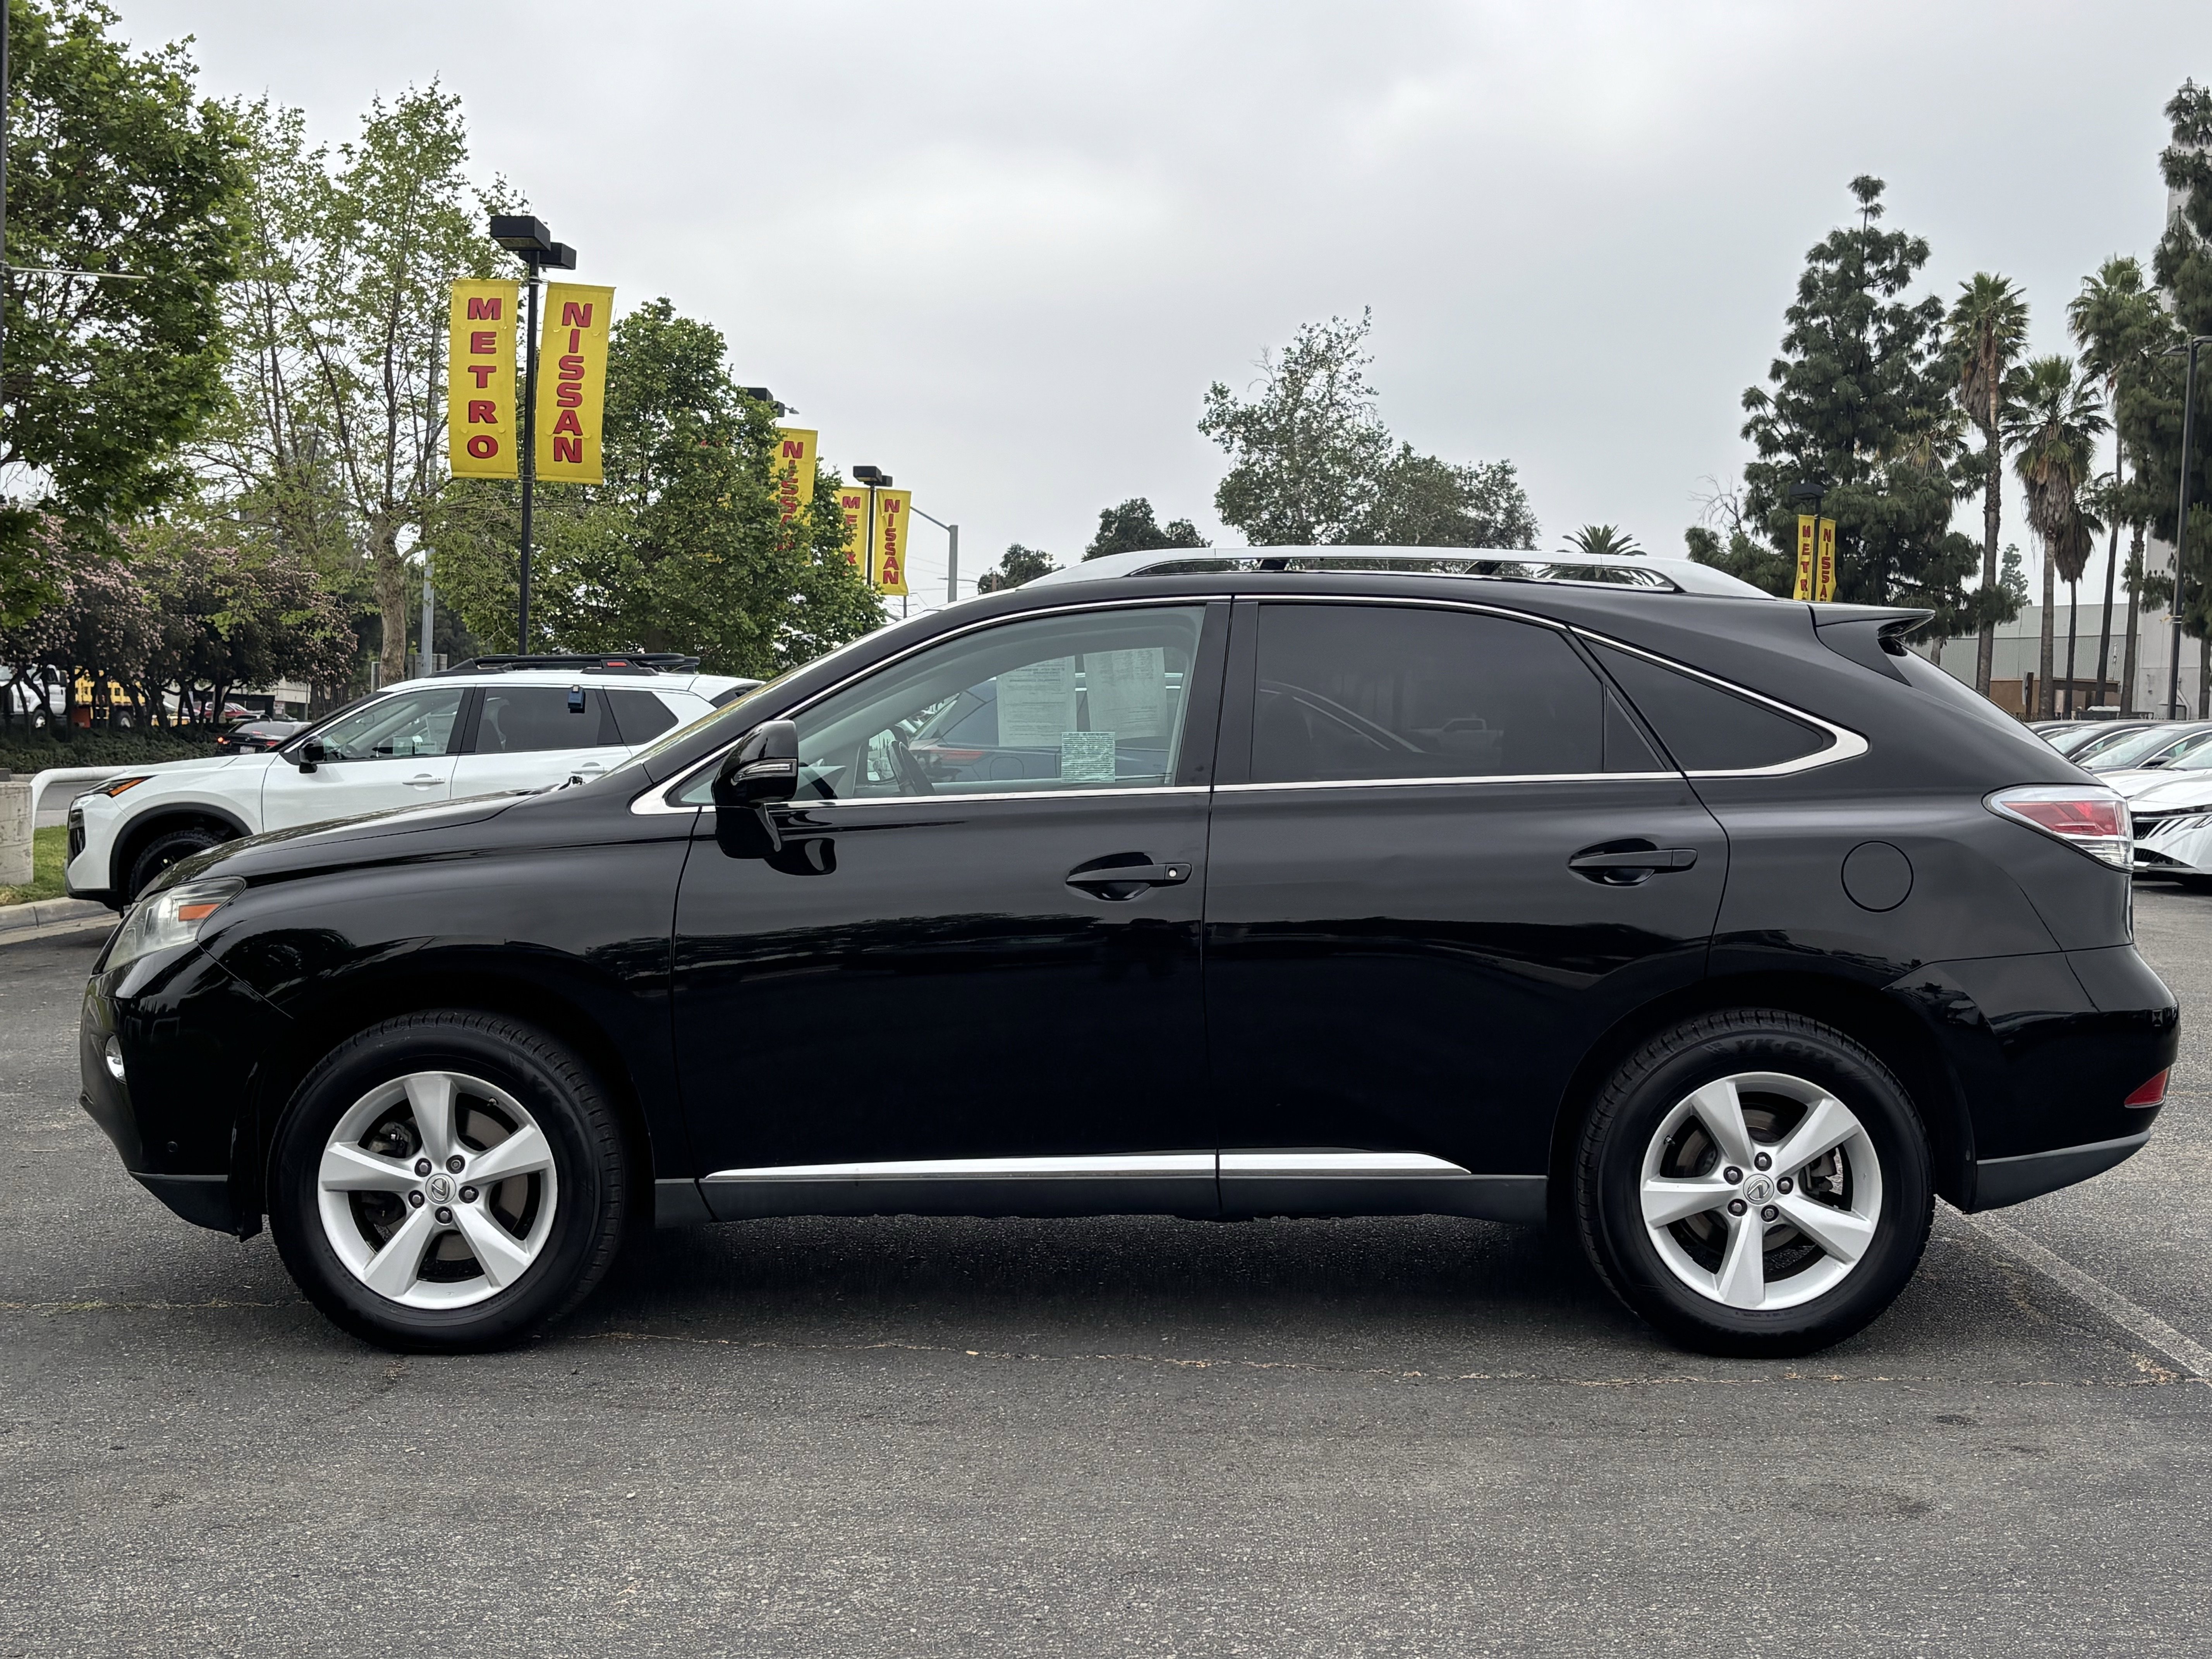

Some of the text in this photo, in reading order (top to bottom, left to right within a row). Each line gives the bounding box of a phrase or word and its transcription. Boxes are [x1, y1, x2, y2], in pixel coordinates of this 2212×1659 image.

[467, 297, 502, 459] METRO
[553, 302, 593, 463] NISSAN
[883, 499, 900, 584] NISSAN
[1800, 525, 1811, 600] METR
